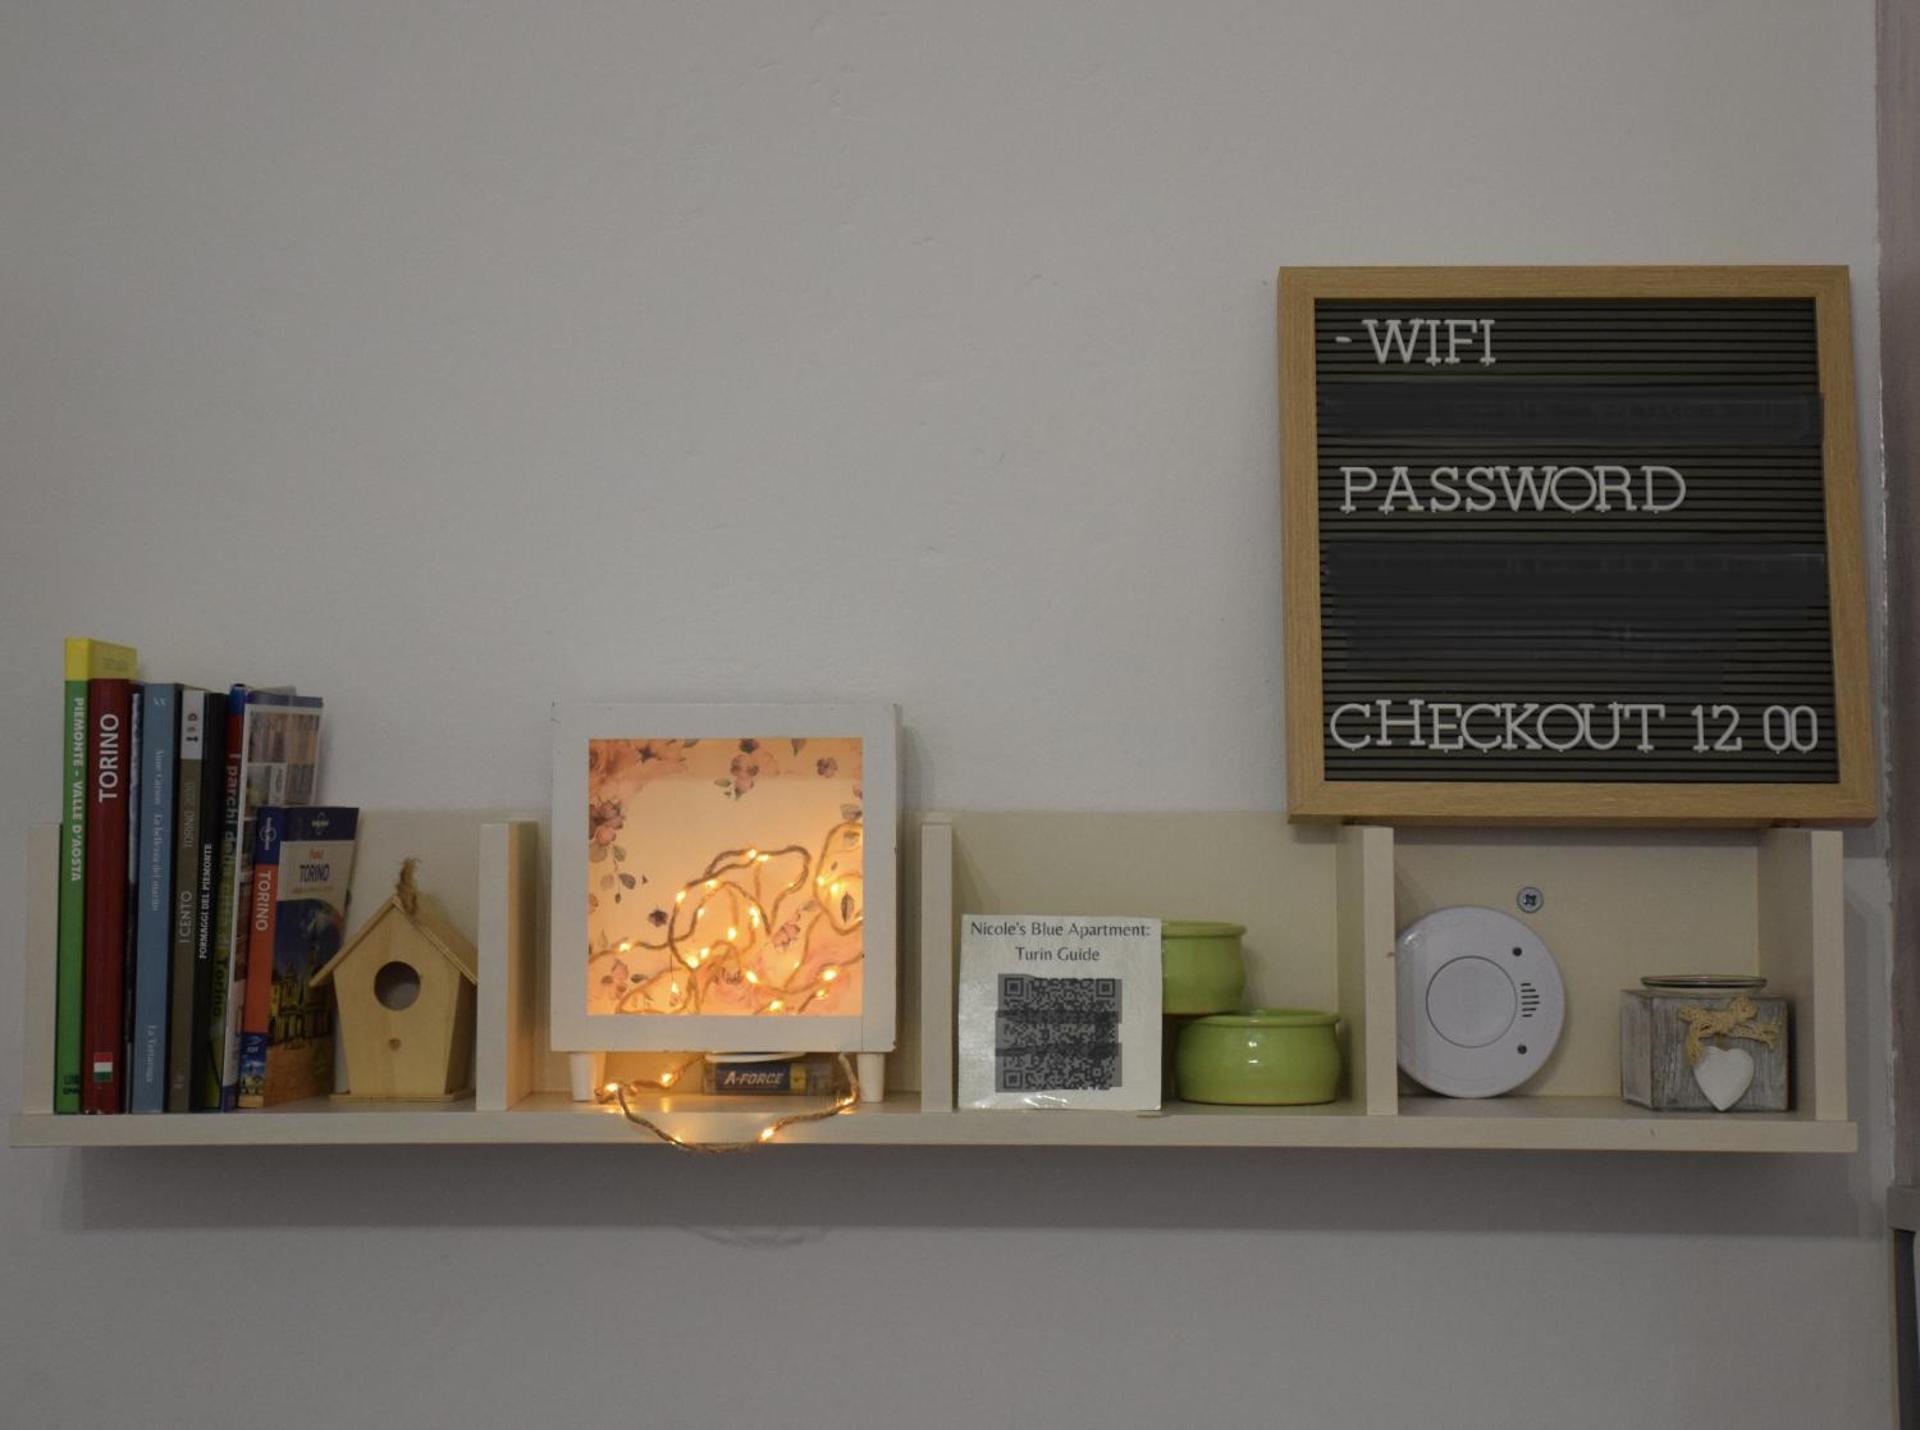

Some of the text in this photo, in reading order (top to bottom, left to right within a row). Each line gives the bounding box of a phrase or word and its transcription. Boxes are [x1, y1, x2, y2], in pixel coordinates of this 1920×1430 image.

[1362, 318, 1496, 365] WIFI
[1340, 466, 1687, 513] PASSWORD
[73, 697, 85, 767] PIEMONTE
[1330, 699, 1818, 753] CHECKOUT 12 00
[99, 713, 120, 803] TORINO
[72, 780, 83, 820] VALLE
[225, 765, 238, 824] parchi
[71, 825, 82, 881] D'AOSTA
[222, 830, 237, 876] della
[179, 891, 193, 937] CENTO
[198, 843, 213, 959] FORMAGGI DEL PIEMONTE
[255, 870, 272, 932] TORINO
[970, 921, 1151, 939] Nicole's Blue Apartment:
[1015, 946, 1100, 961] Turin Guide
[212, 957, 227, 1018] Torino
[724, 1070, 784, 1085] A-FORCE
